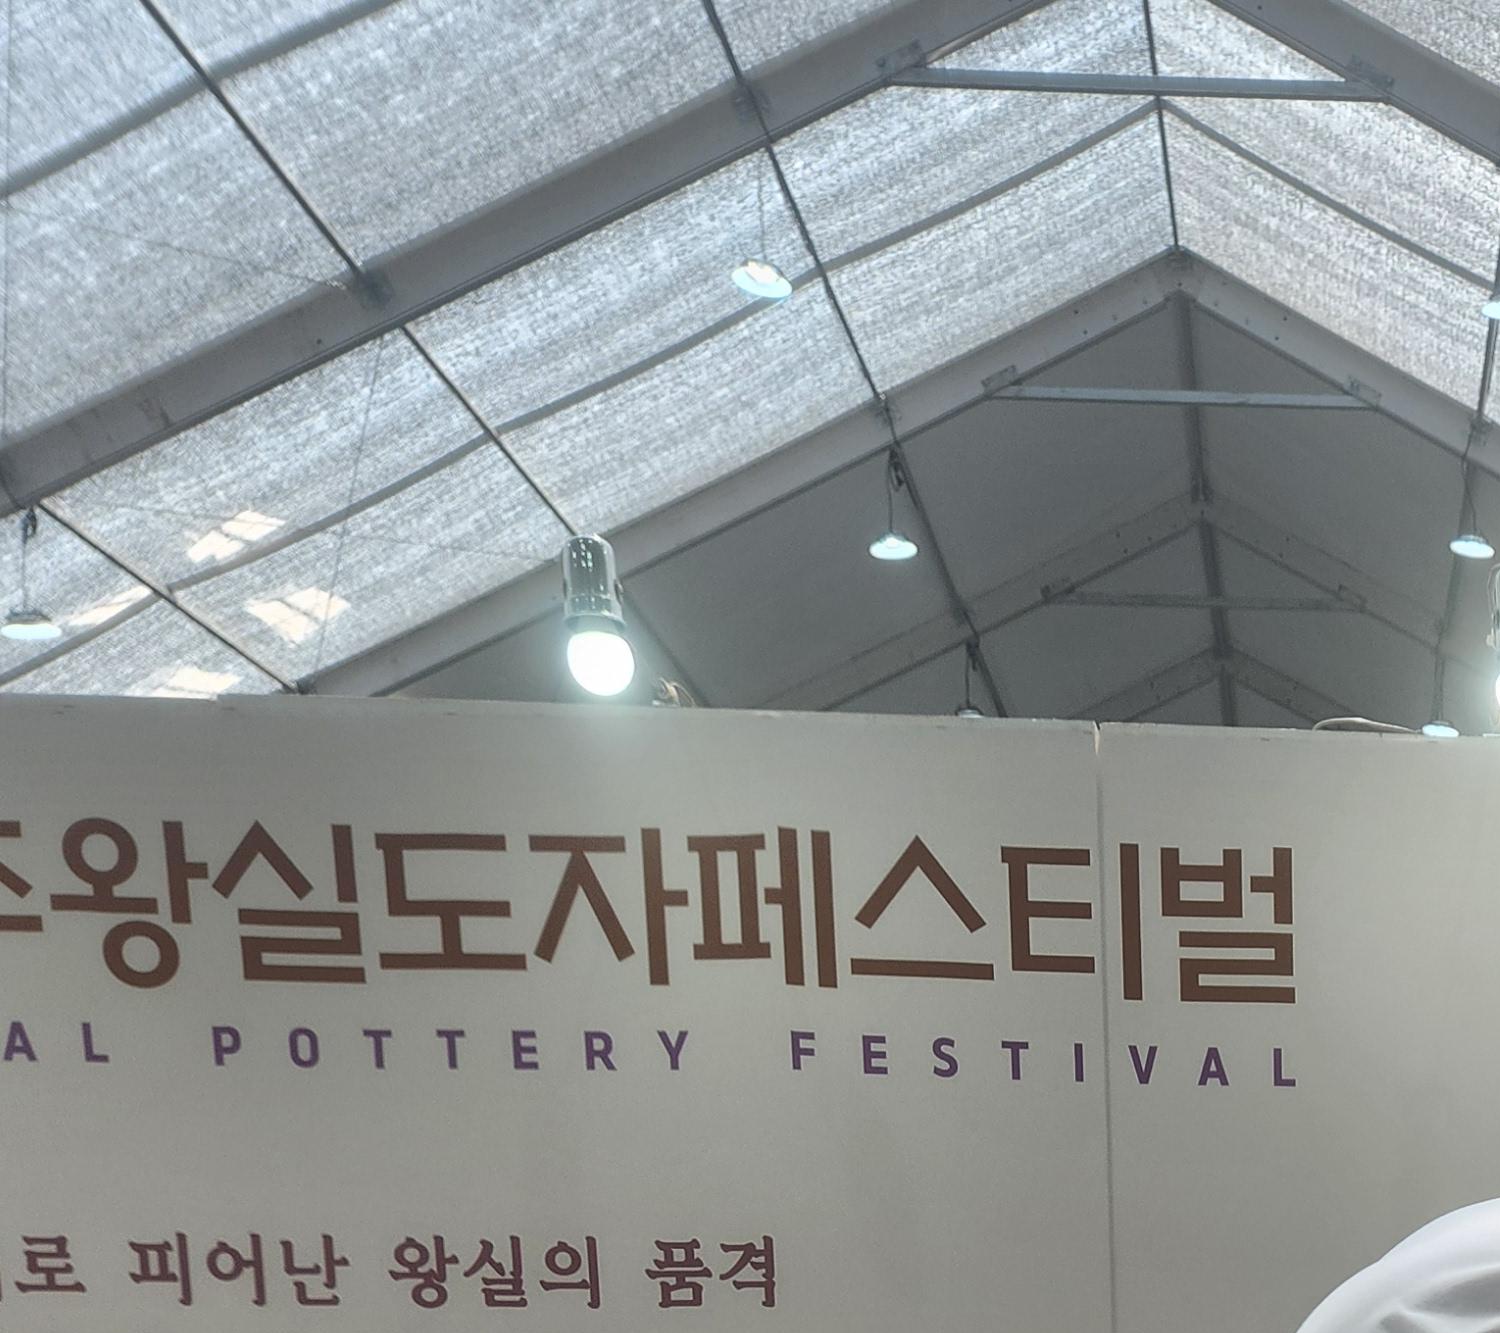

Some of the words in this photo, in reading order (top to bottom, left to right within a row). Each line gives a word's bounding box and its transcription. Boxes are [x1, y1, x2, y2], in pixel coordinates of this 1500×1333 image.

[0, 816, 1296, 1004] 왕실도자페스티벌
[3, 1021, 110, 1063] AL
[211, 1025, 689, 1071] POTTERY
[790, 1030, 1297, 1088] FESTIVAL
[0, 1234, 87, 1301] 로
[128, 1231, 350, 1307] 피어난
[388, 1234, 602, 1310] 왕실의
[644, 1235, 777, 1309] 품격
